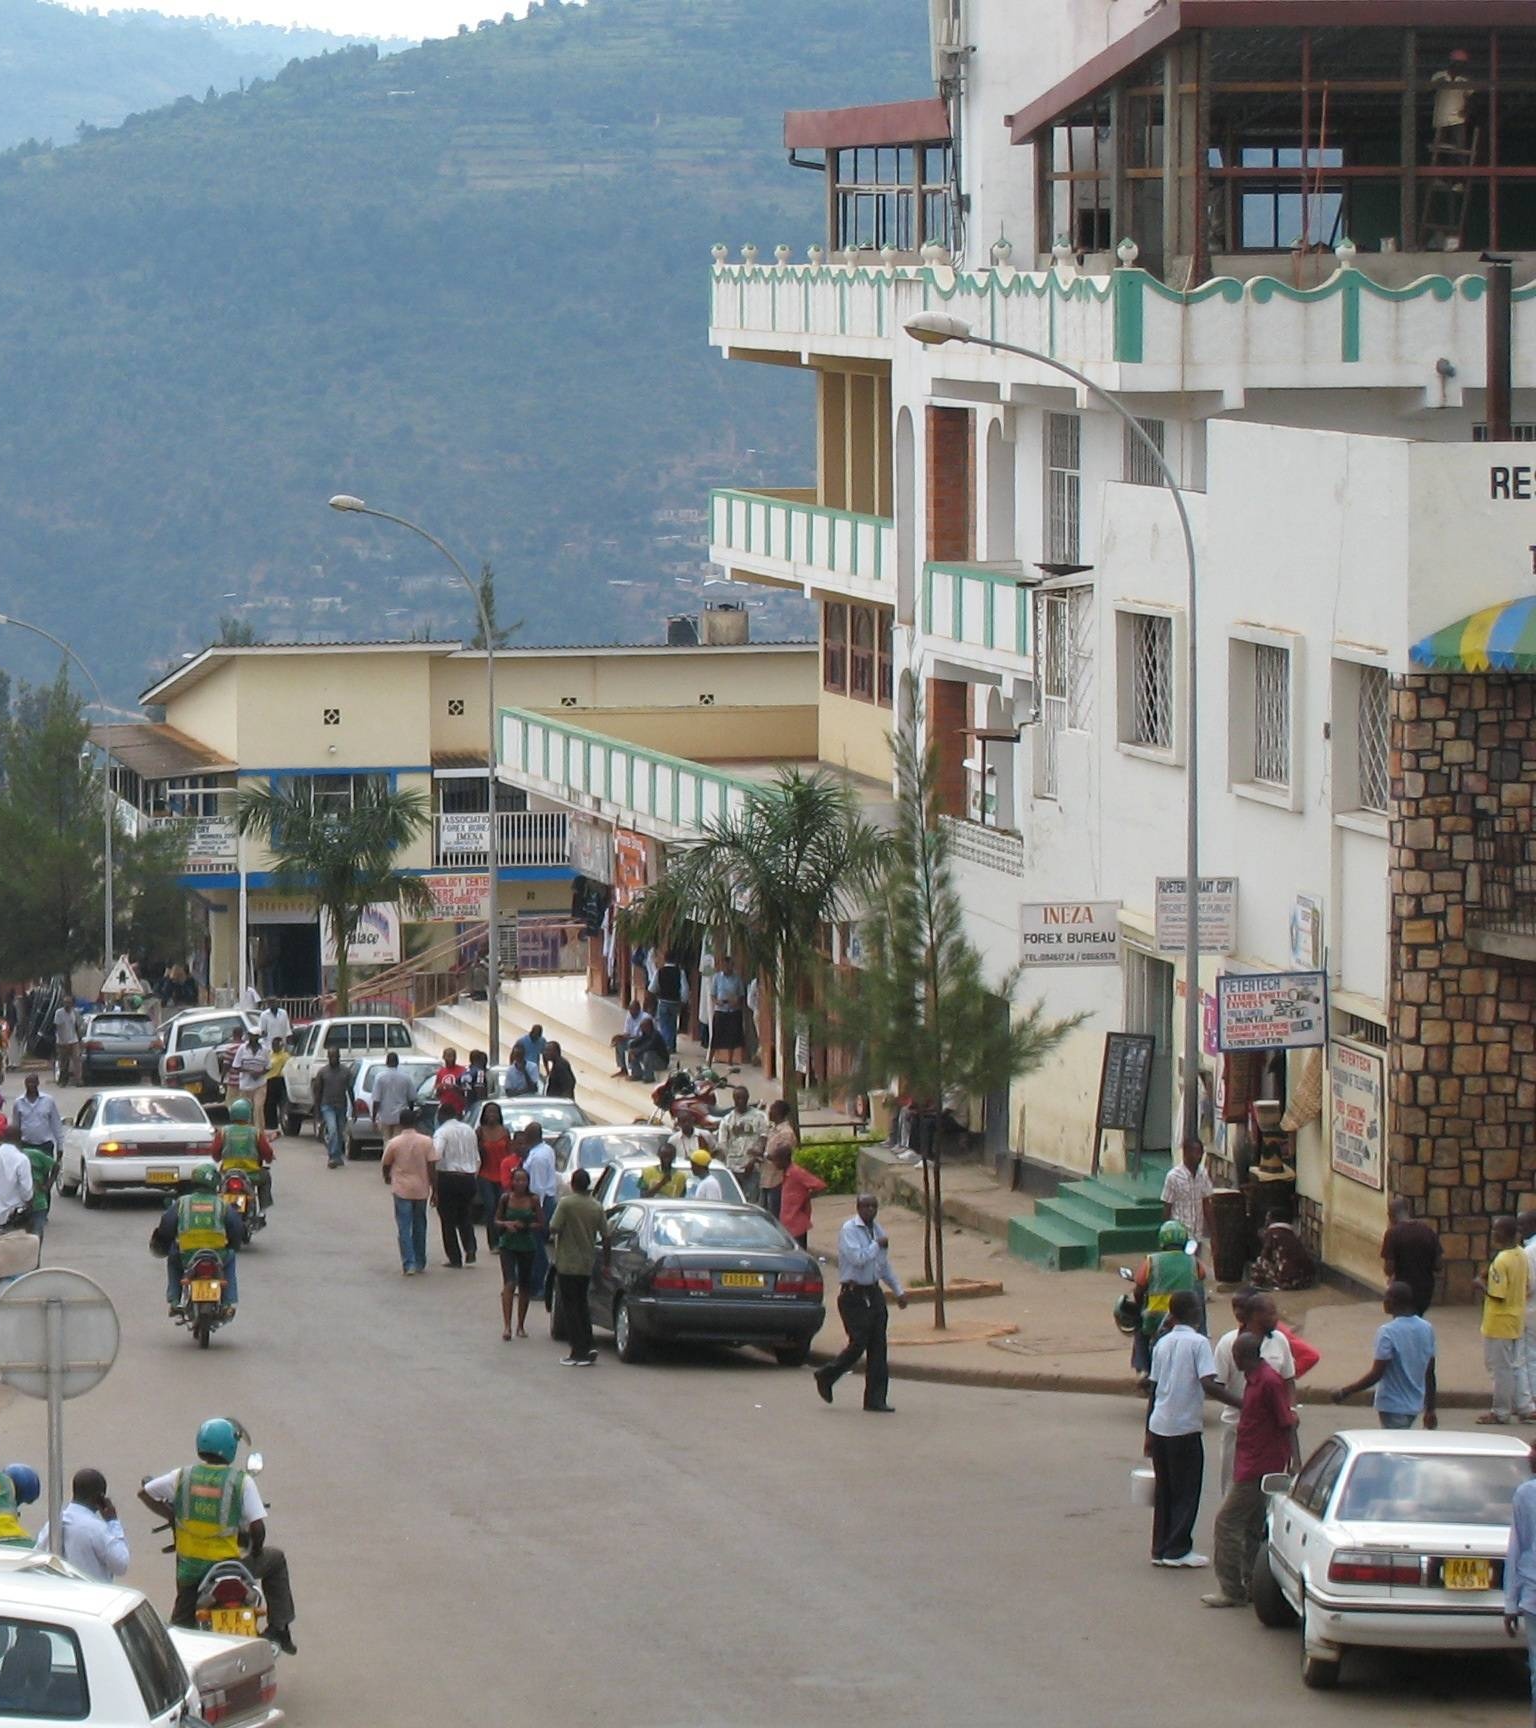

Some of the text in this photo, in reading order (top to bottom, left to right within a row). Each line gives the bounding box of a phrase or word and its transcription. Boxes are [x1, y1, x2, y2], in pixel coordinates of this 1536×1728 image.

[1490, 466, 1536, 499] RE
[445, 815, 490, 824] ASSOCIATIO
[1043, 906, 1095, 924] INEZA
[347, 931, 380, 945] alace
[1024, 931, 1117, 945] FOREX BUREAU
[1224, 978, 1281, 993] PETERTECH
[1227, 1001, 1265, 1009] EXPRESS
[1453, 1561, 1476, 1575] RAA
